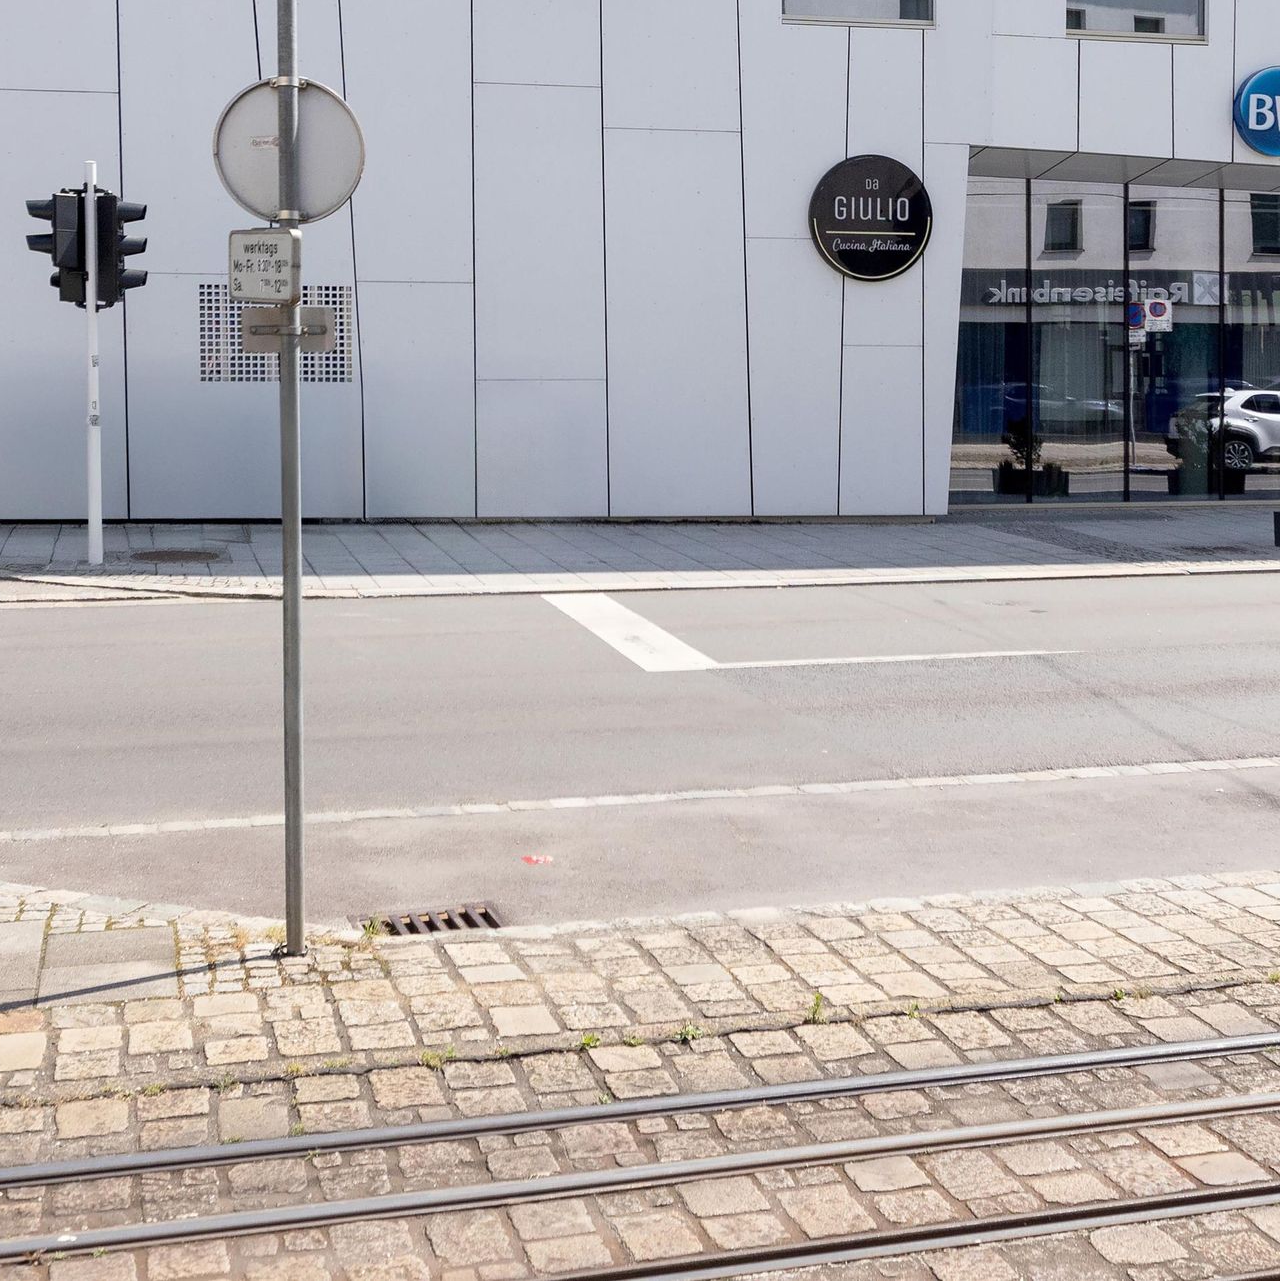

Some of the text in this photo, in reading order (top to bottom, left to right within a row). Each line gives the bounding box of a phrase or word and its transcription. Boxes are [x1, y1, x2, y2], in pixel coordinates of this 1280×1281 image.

[834, 196, 909, 221] GIULIO
[243, 240, 278, 257] werktags
[832, 237, 912, 253] Cucina Italiana
